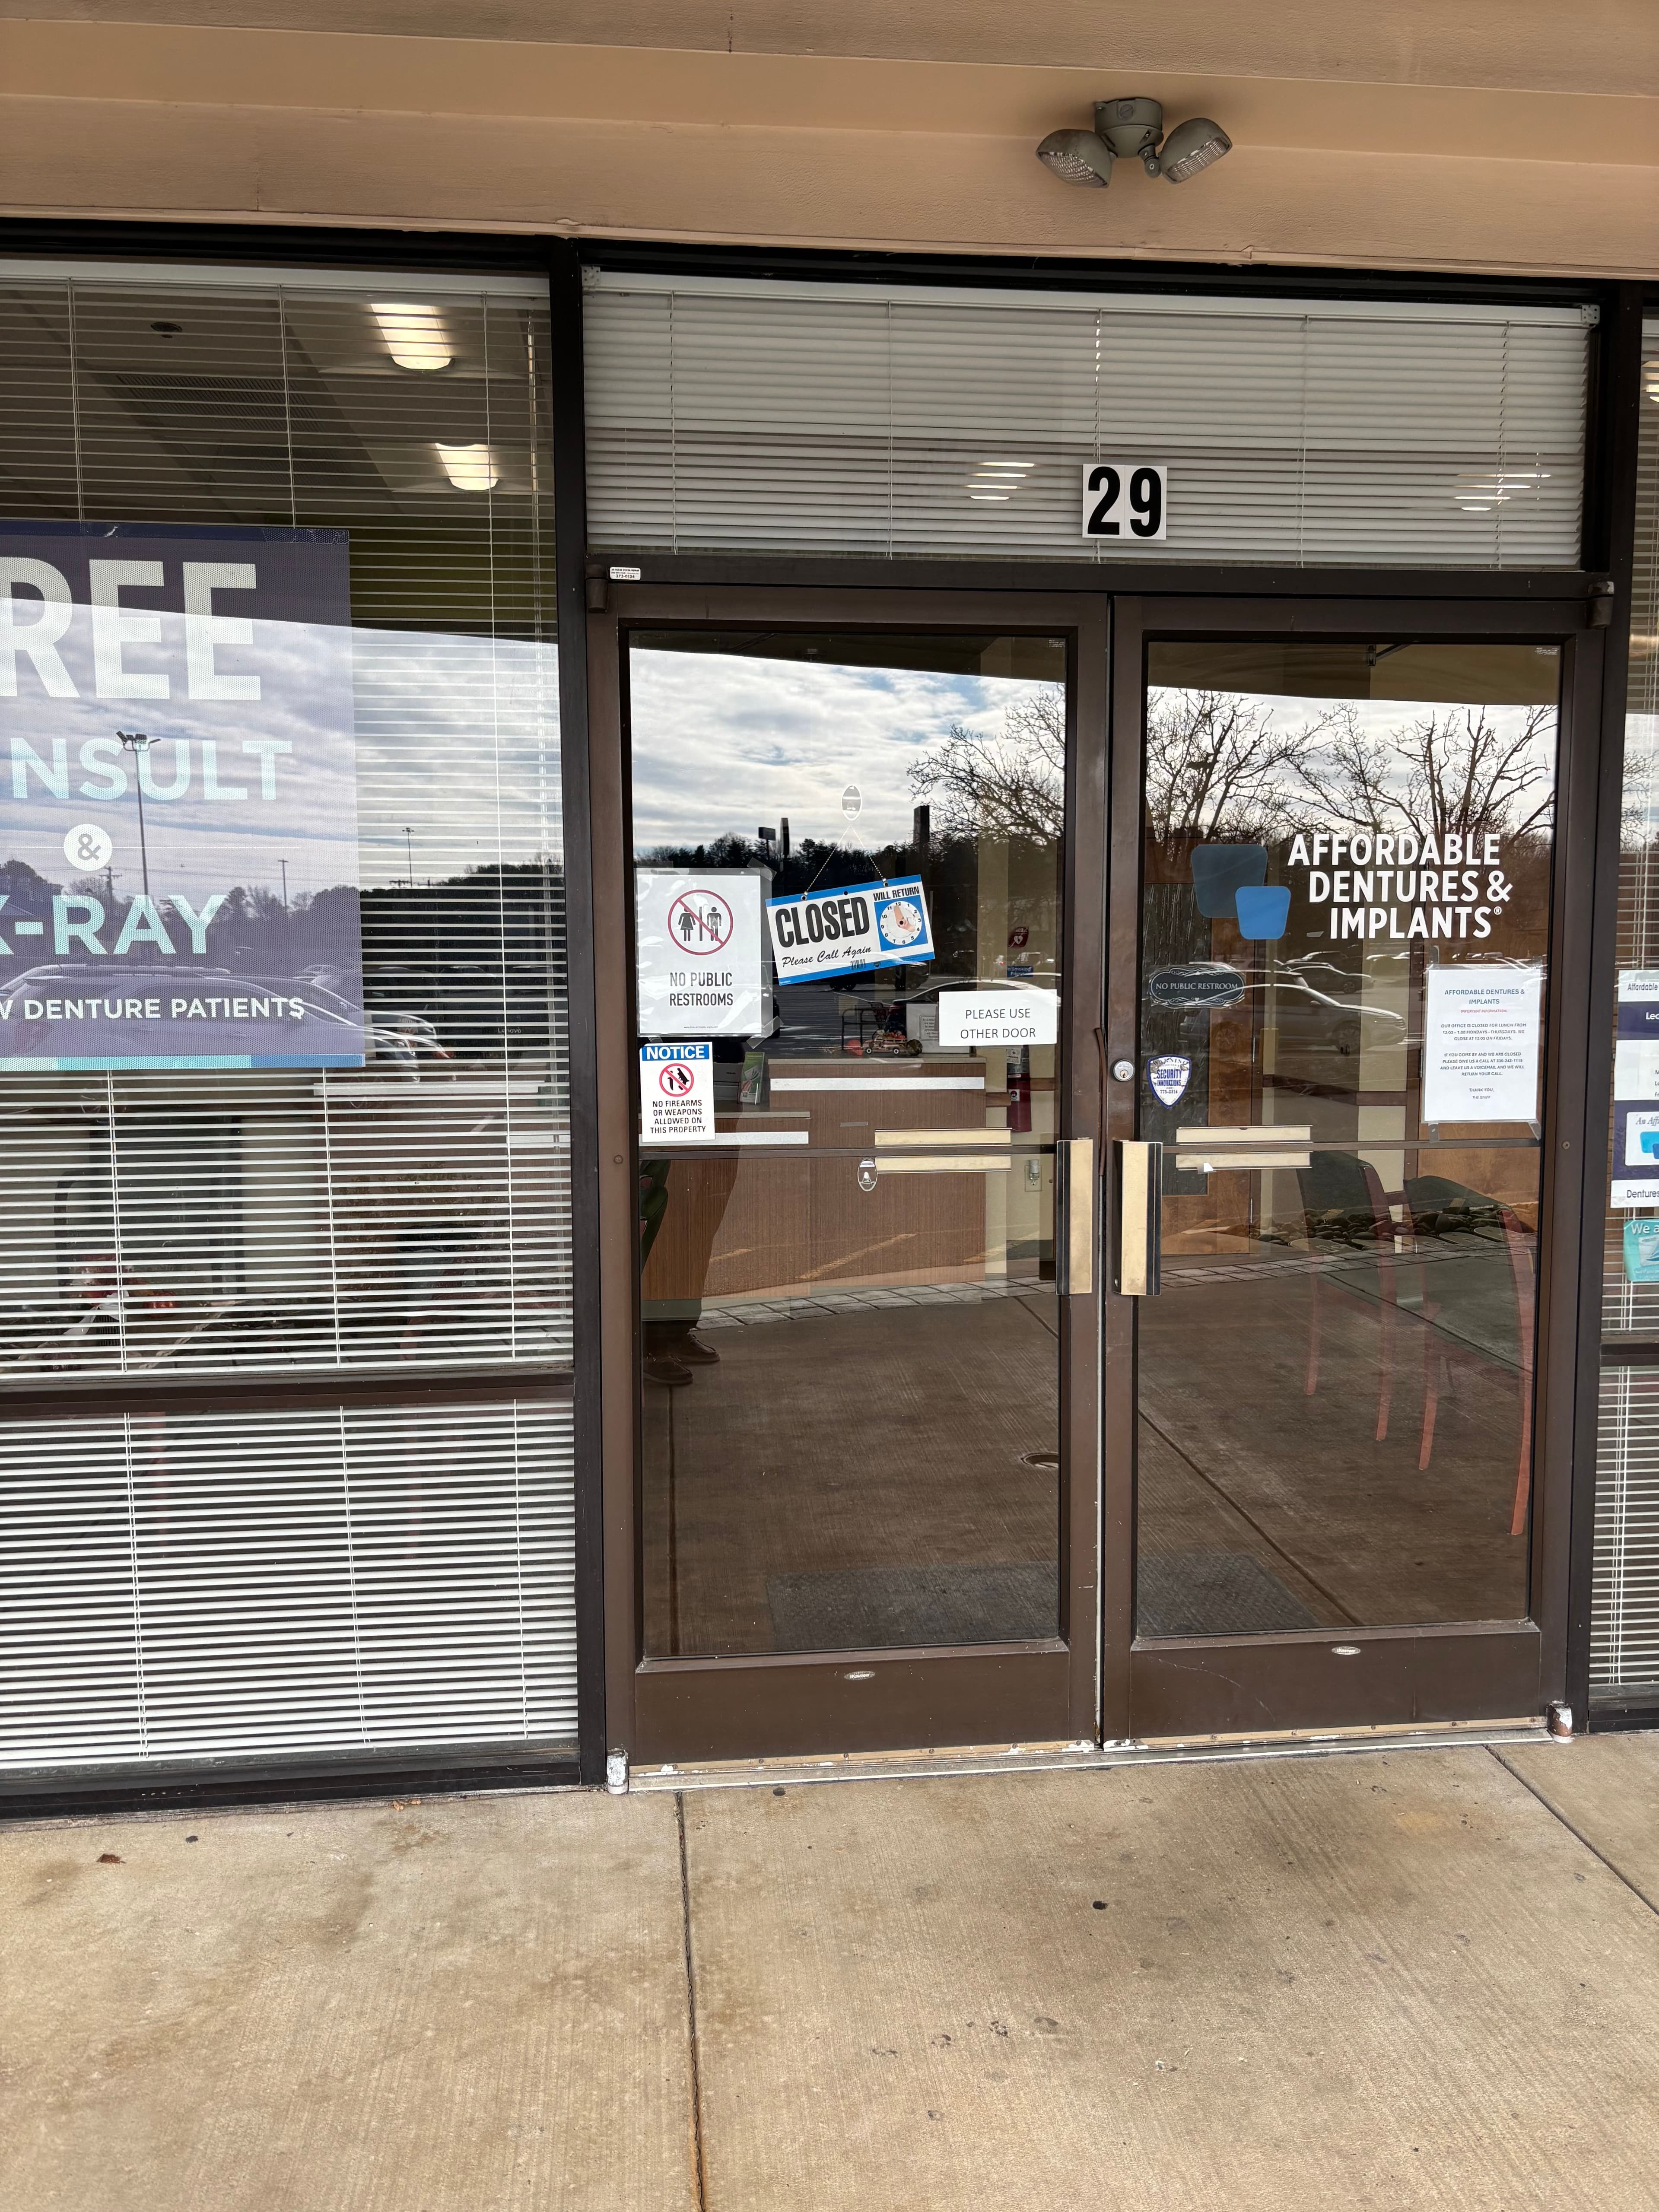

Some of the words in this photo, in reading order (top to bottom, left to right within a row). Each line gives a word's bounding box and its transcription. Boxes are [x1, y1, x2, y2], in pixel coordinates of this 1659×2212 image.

[1087, 466, 1162, 537] 29
[0, 556, 261, 700] REE
[10, 737, 292, 801] NSULT
[77, 833, 102, 861] &
[1287, 833, 1500, 866] AFFORDABLE
[873, 891, 890, 901] WILL
[892, 886, 919, 898] RETURN
[1309, 871, 1478, 903] DENTURES
[1487, 871, 1513, 902] &
[775, 896, 870, 948] CLOSED
[782, 956, 814, 967] Please
[817, 949, 839, 963] Call
[842, 946, 872, 958] Again
[670, 972, 686, 986] NO
[690, 972, 732, 986] PUBLIC
[24, 999, 162, 1020] DENTURE
[171, 997, 305, 1019] PATIENTS
[670, 993, 733, 1006] RESTROOMS
[966, 1009, 1005, 1019] PLEASE
[1010, 1008, 1030, 1018] USE
[960, 1029, 998, 1039] OTHER
[1002, 1028, 1036, 1038] DOOR
[647, 1046, 705, 1060] NOTICE
[1157, 1069, 1182, 1079] SECURITY
[1631, 1223, 1650, 1234] We
